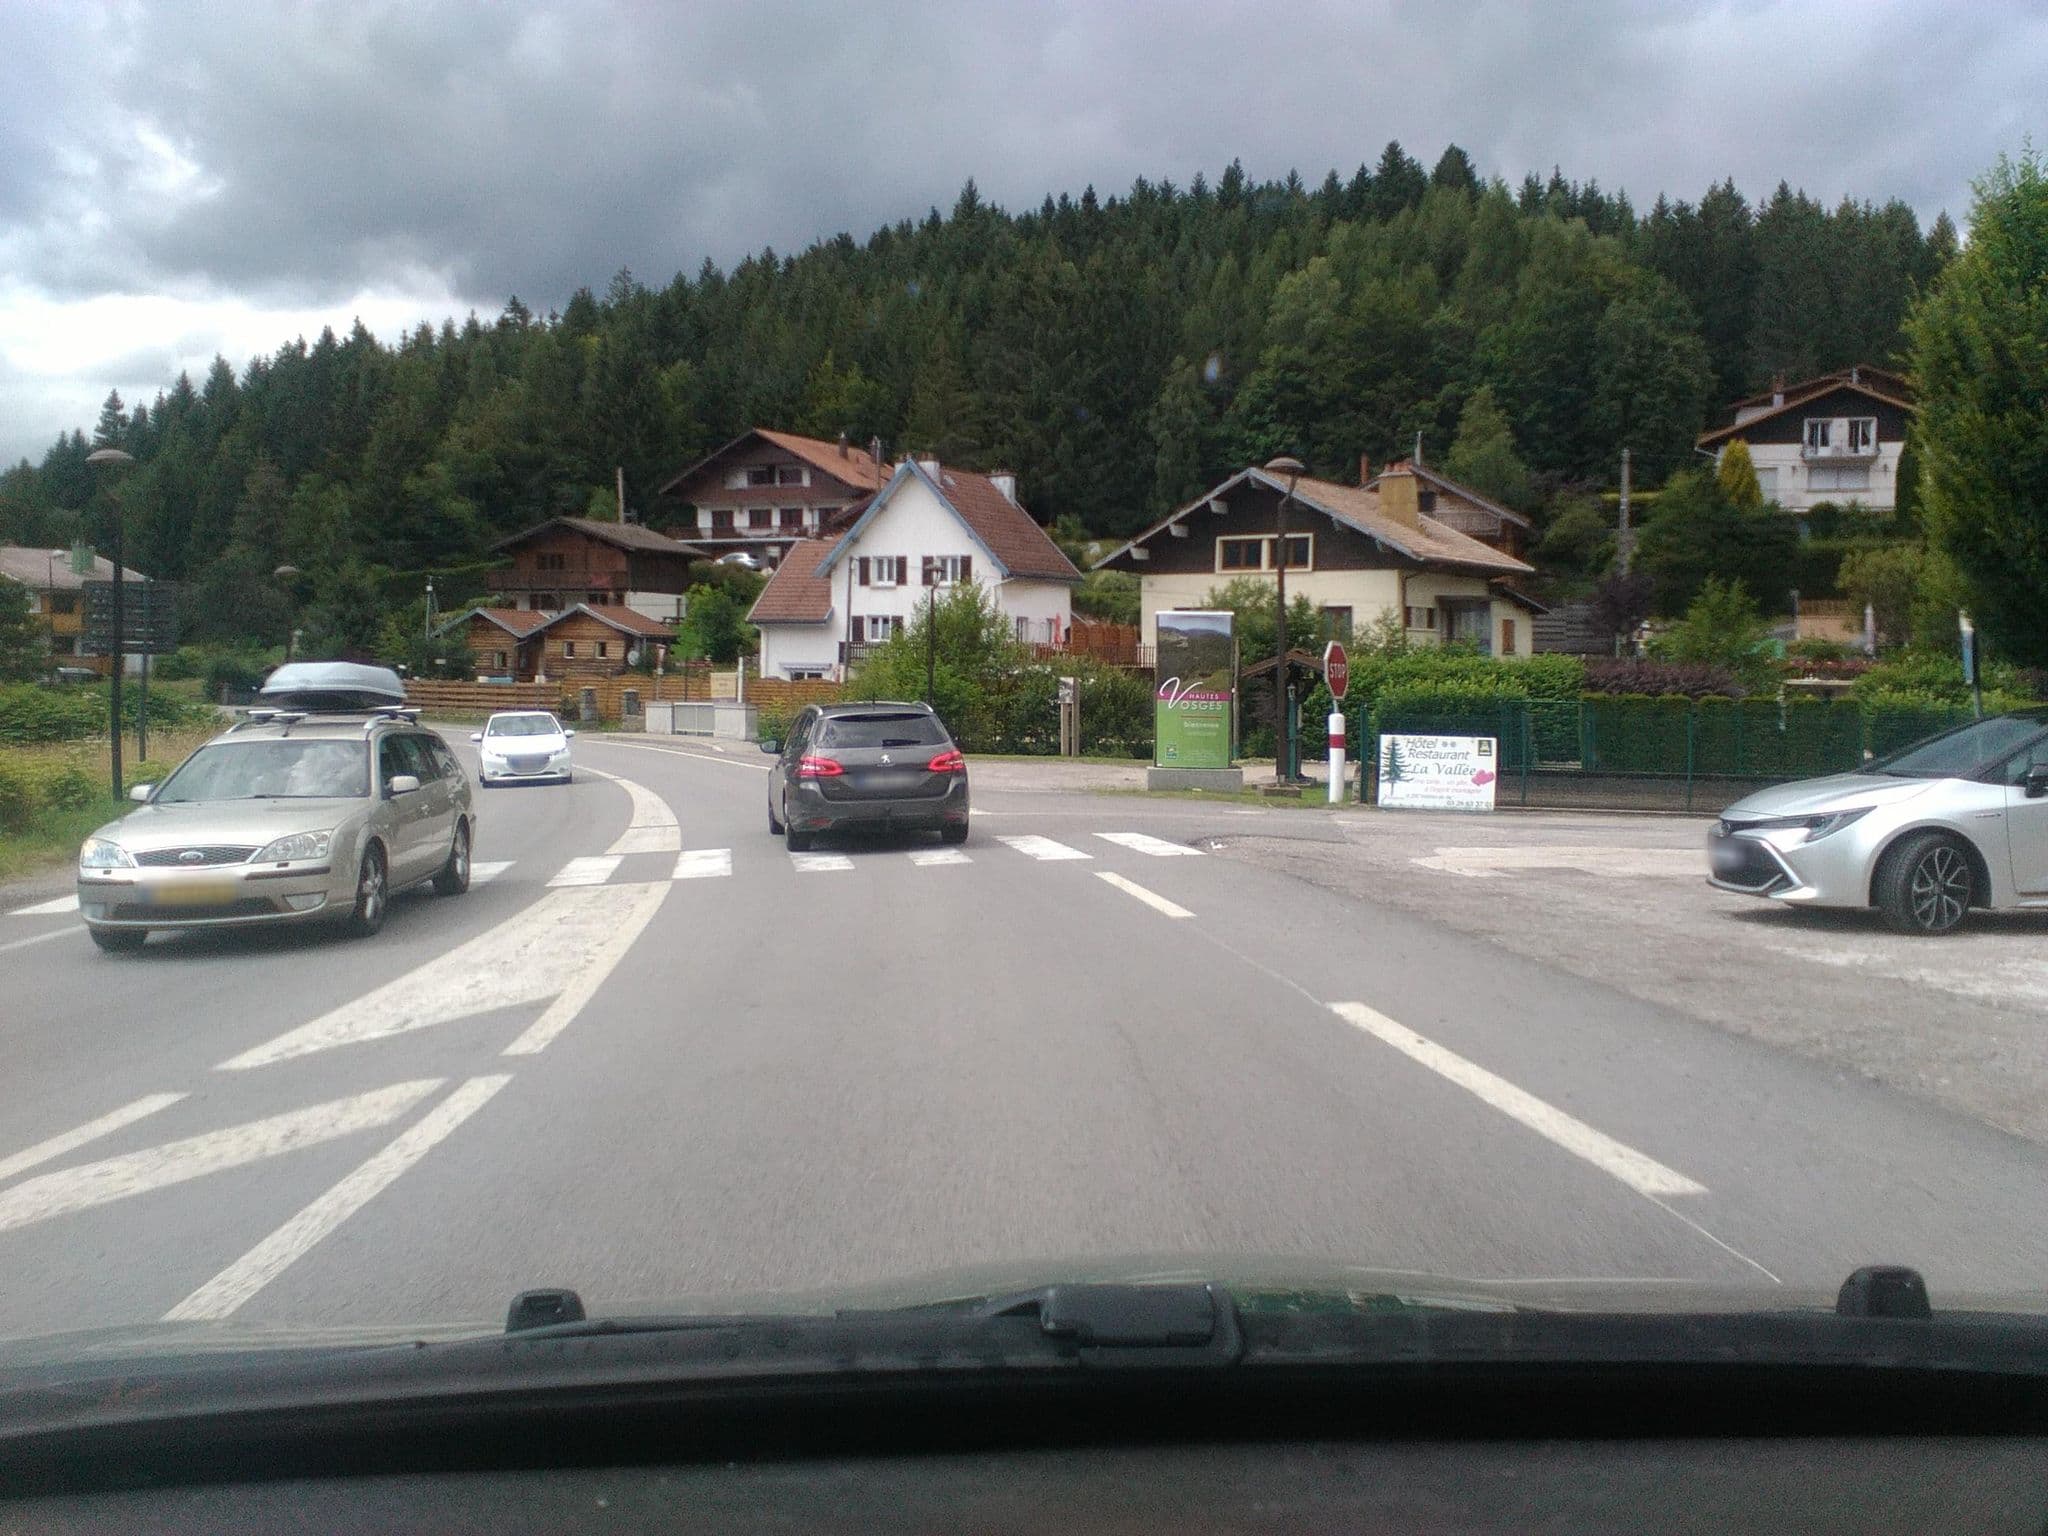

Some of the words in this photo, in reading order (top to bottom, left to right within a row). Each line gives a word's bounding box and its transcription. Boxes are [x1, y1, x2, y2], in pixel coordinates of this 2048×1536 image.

[1329, 663, 1346, 678] STOP
[1404, 737, 1438, 749] Hôtel
[1407, 748, 1471, 761] Restaurant
[1411, 763, 1428, 775] La
[1436, 762, 1477, 776] Vallée
